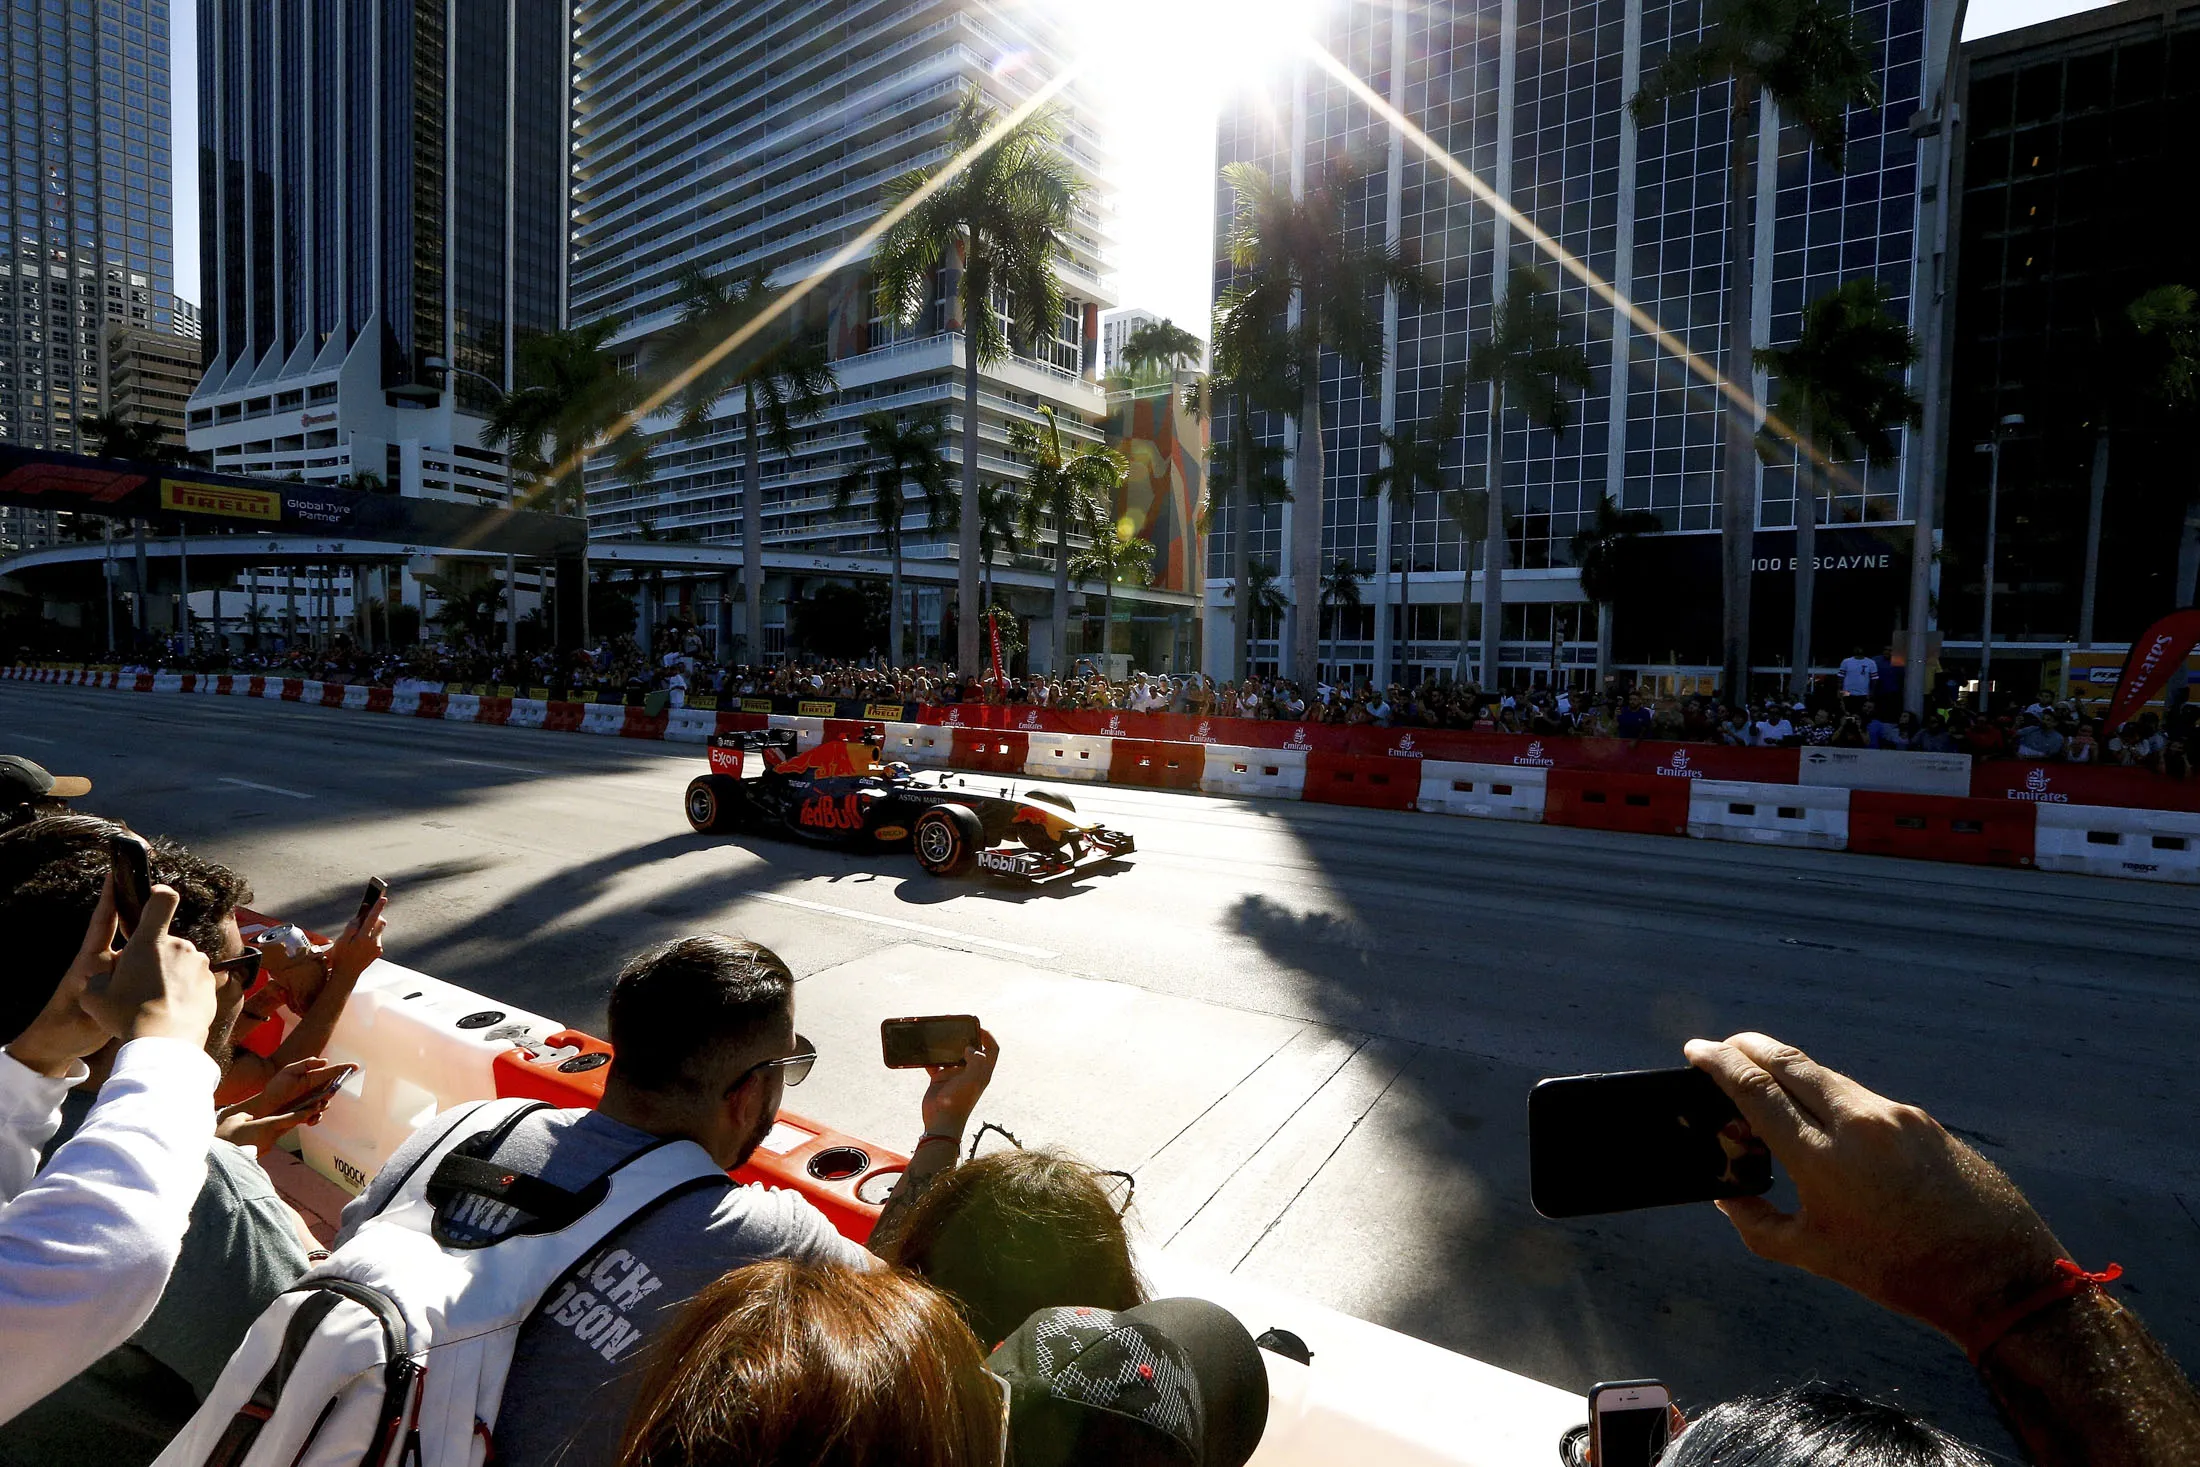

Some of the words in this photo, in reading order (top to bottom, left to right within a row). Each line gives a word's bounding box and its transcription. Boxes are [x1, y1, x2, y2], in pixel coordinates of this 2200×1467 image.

[173, 486, 271, 514] PIRELLI
[287, 499, 324, 511] Global
[325, 503, 351, 514] Tyre
[298, 510, 341, 523] Partner
[1789, 554, 1889, 571] BSCAYNE
[801, 703, 832, 714] PIRELLI
[867, 705, 900, 718] PIRELLI
[1018, 722, 1043, 730] Emirates
[1100, 728, 1127, 737] Emirates
[1189, 734, 1216, 744] Emirates
[1283, 741, 1312, 751] Emirates
[712, 750, 738, 768] Exxon
[1388, 747, 1423, 759] Emirates
[1513, 756, 1555, 766] Emirates
[1656, 766, 1702, 778] Emirates
[2007, 788, 2068, 803] Emirates
[977, 853, 1016, 873] Mobil
[333, 1155, 366, 1188] YODOCK
